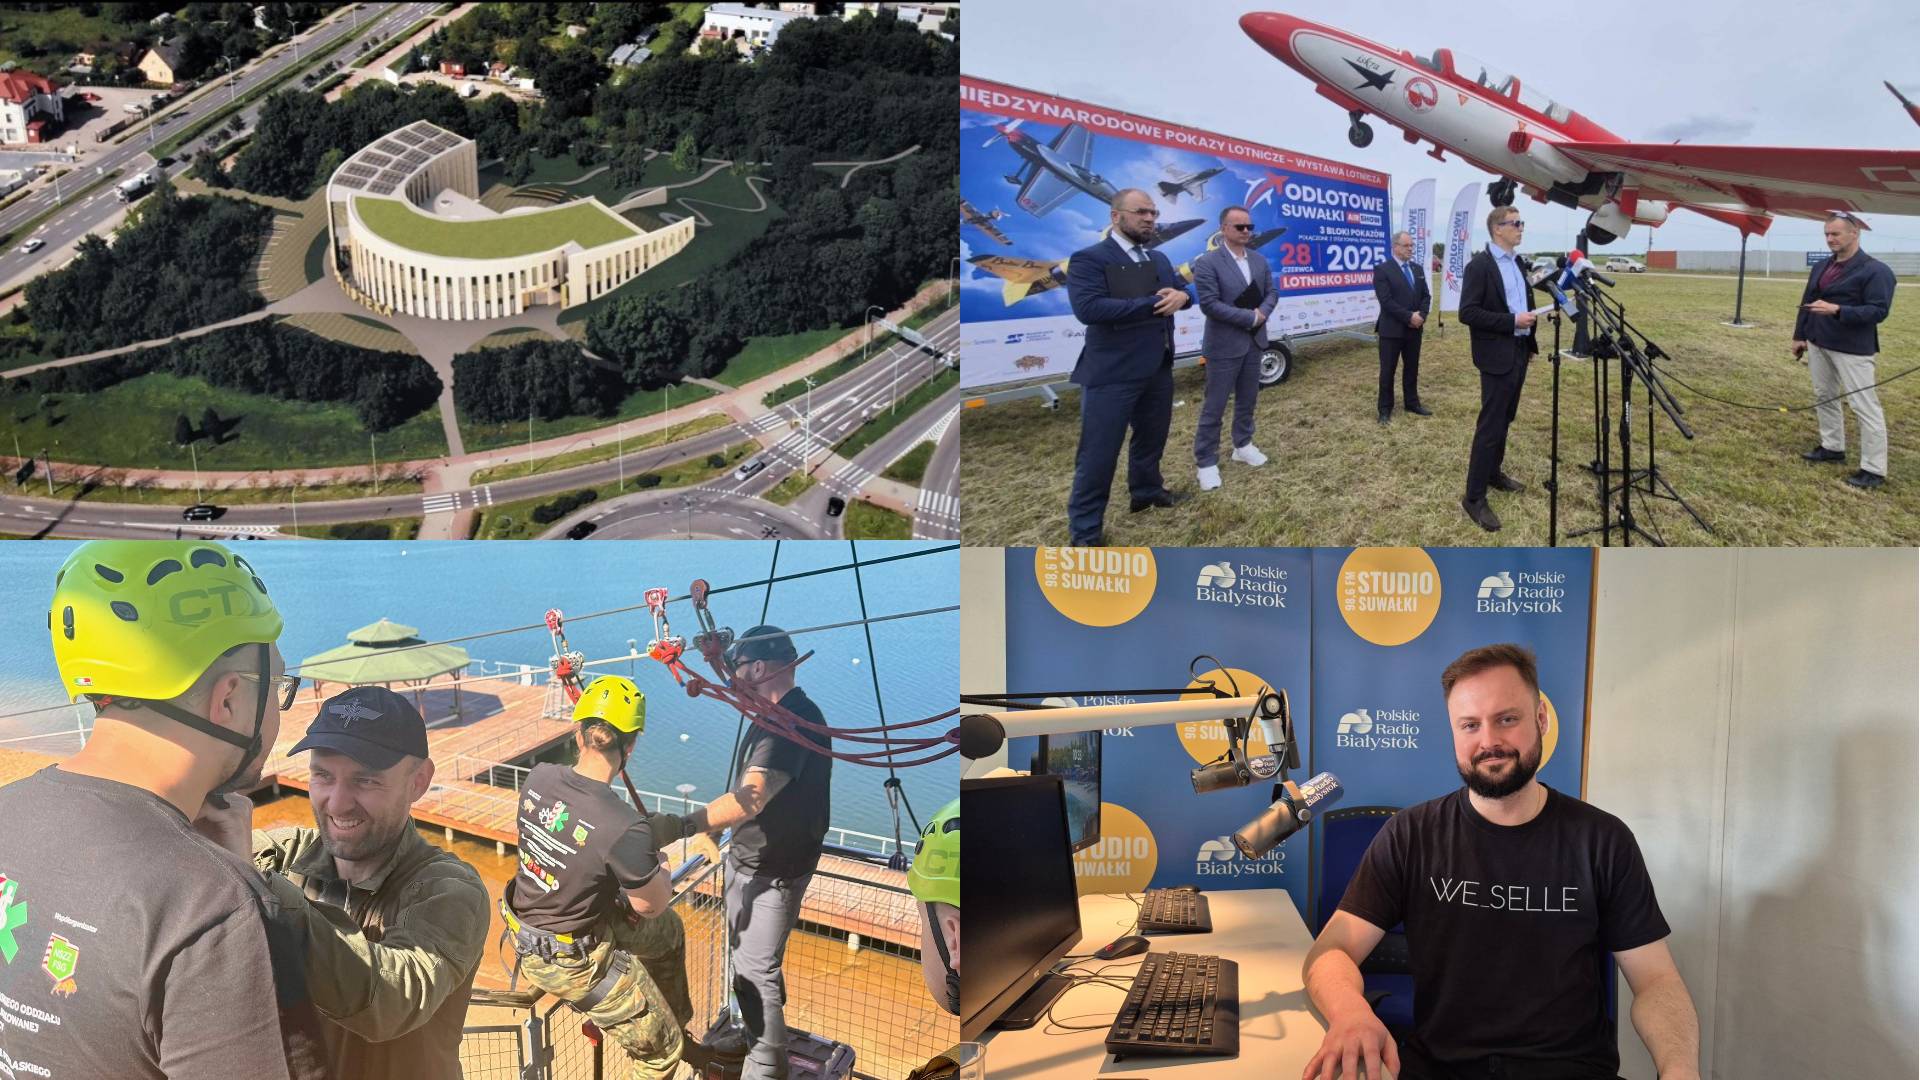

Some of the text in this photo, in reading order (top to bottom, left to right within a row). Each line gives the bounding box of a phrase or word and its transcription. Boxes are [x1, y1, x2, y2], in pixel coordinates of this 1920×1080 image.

[1165, 124, 1226, 151] POKAZY
[1228, 143, 1286, 164] LOTNICZE
[1295, 158, 1345, 176] WYSTAWA
[1345, 169, 1382, 184] LOTNICZA
[1285, 183, 1384, 212] ODLOTOWE
[1281, 204, 1344, 221] SUWAŁKI
[1319, 226, 1385, 239] 3 BLOKI POKAZÓW
[1449, 211, 1462, 273] ODLOTOWE
[1280, 243, 1312, 266] 28
[1326, 245, 1387, 271] 2025
[1283, 273, 1375, 289] LOTNISKO SUWA
[1060, 547, 1148, 577] STUDIO
[1239, 564, 1288, 580] Polskie
[1518, 571, 1565, 584] Polskie
[1061, 572, 1130, 593] SUWAŁKI
[1239, 578, 1287, 594] Radio
[1358, 571, 1433, 595] STUDIO
[1196, 586, 1286, 608] Białystok
[1517, 586, 1565, 599] Radio
[1359, 596, 1418, 612] SUWAŁKI
[1476, 599, 1563, 616] Białystok
[1376, 709, 1420, 721] Polskie
[1199, 725, 1265, 742] SUWKI
[1375, 723, 1420, 735] Radio
[1336, 734, 1418, 750] Białystok
[1305, 781, 1339, 807] Białystok
[1073, 836, 1150, 859] UDIO
[1074, 861, 1131, 877] UWAŁKI
[1196, 861, 1285, 877] Białystok
[20, 1003, 61, 1026] ODDZIAŁU
